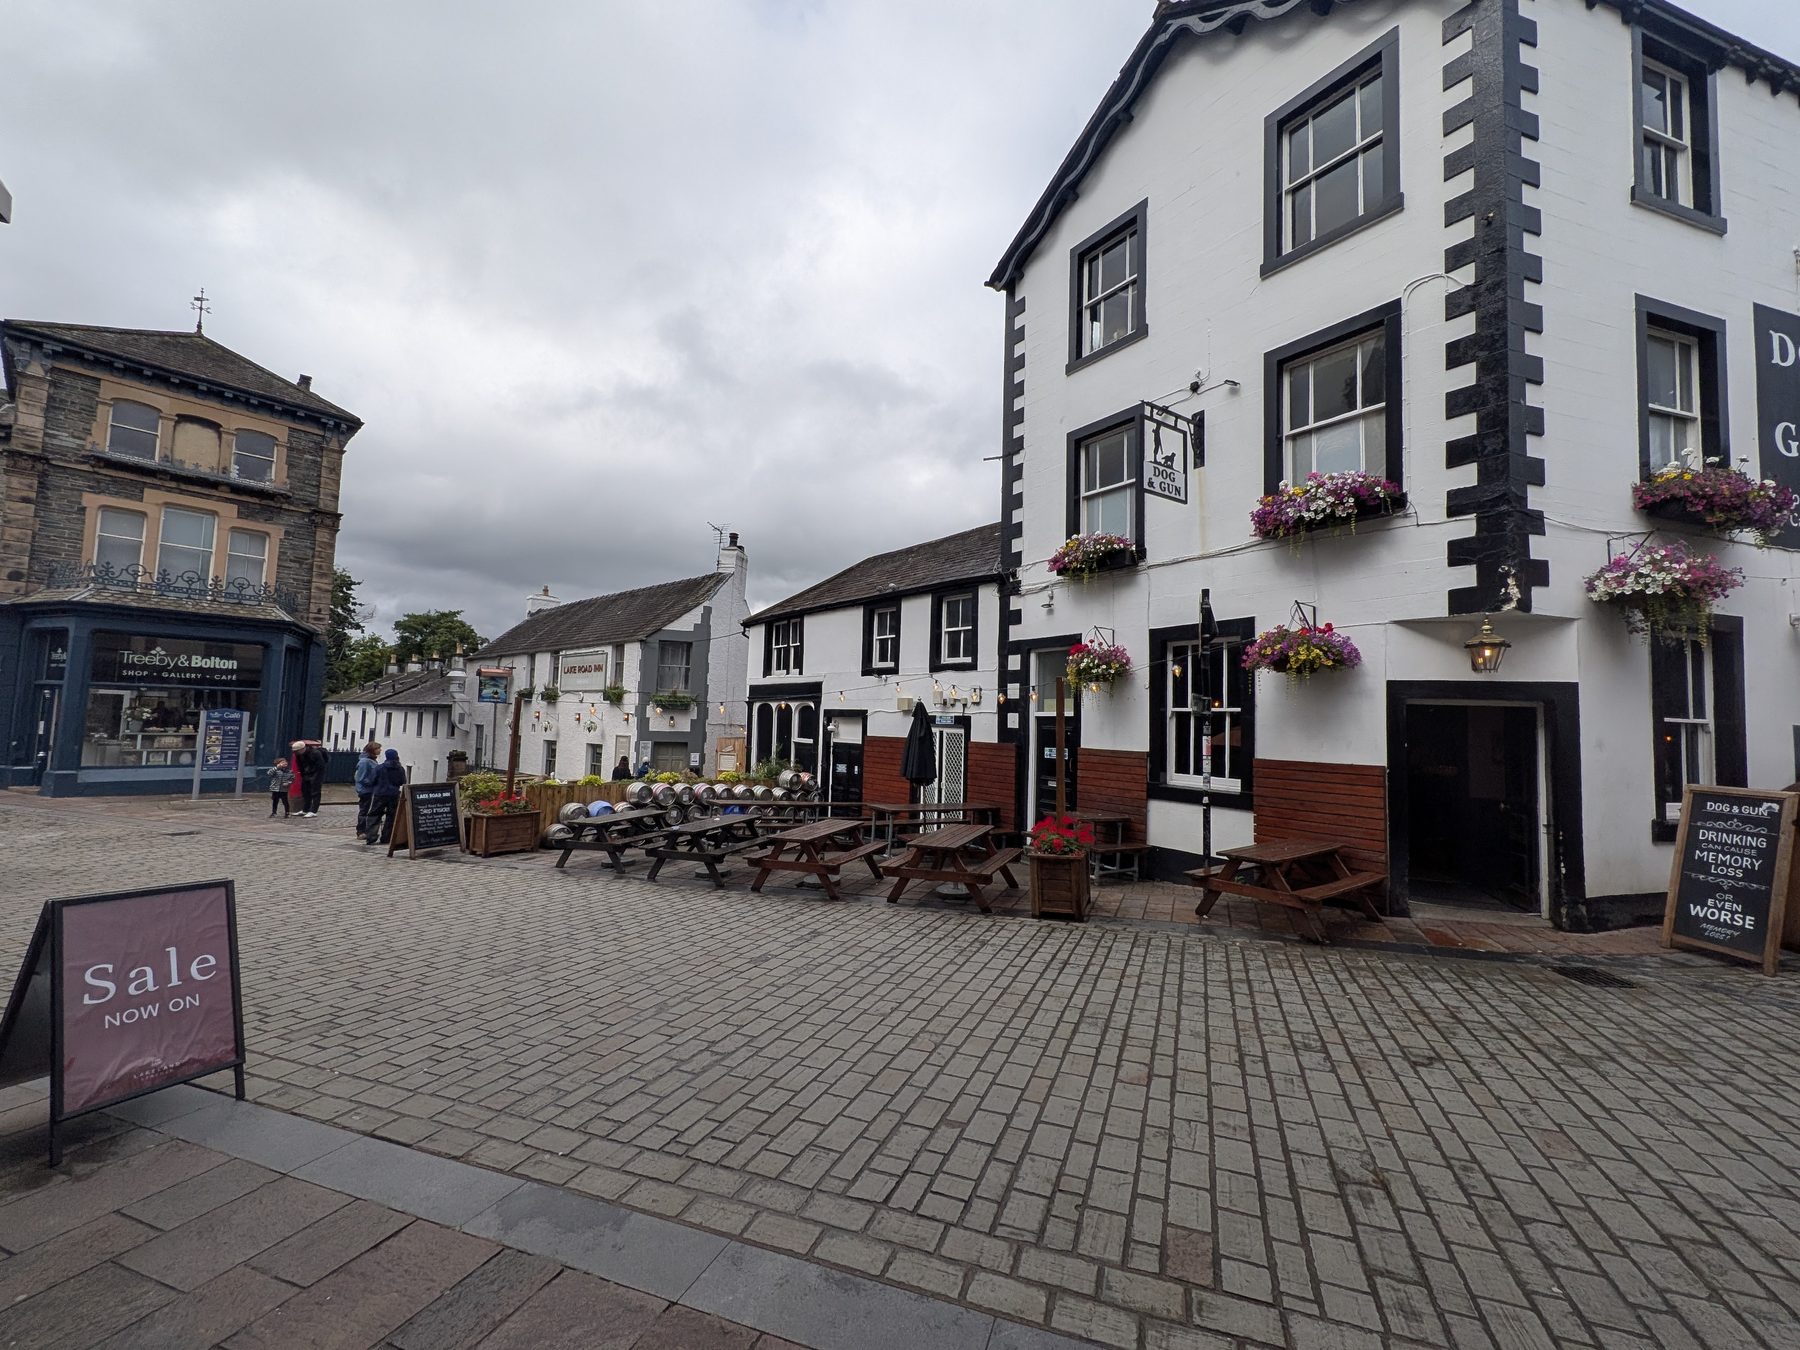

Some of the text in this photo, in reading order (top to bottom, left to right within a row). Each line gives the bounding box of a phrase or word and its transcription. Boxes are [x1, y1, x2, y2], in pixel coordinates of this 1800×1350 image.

[1152, 465, 1176, 483] DOG
[1147, 477, 1182, 497] & GUN
[122, 669, 149, 677] SHOP
[161, 671, 202, 680] GALLERY
[563, 663, 604, 675] LAKE ROAD INN
[1706, 801, 1769, 817] DOG & GUN
[1698, 829, 1768, 849] DRINKING
[1701, 842, 1758, 857] CAN CAUSE
[1694, 849, 1763, 871] MEMORY
[1710, 864, 1744, 878] LOSS
[1715, 892, 1734, 902] OR
[1707, 898, 1743, 913] EVEN
[1689, 903, 1756, 930] WORSE
[1699, 922, 1741, 937] MEMORY
[83, 946, 217, 1005] Sale
[104, 993, 201, 1029] NOW ON
